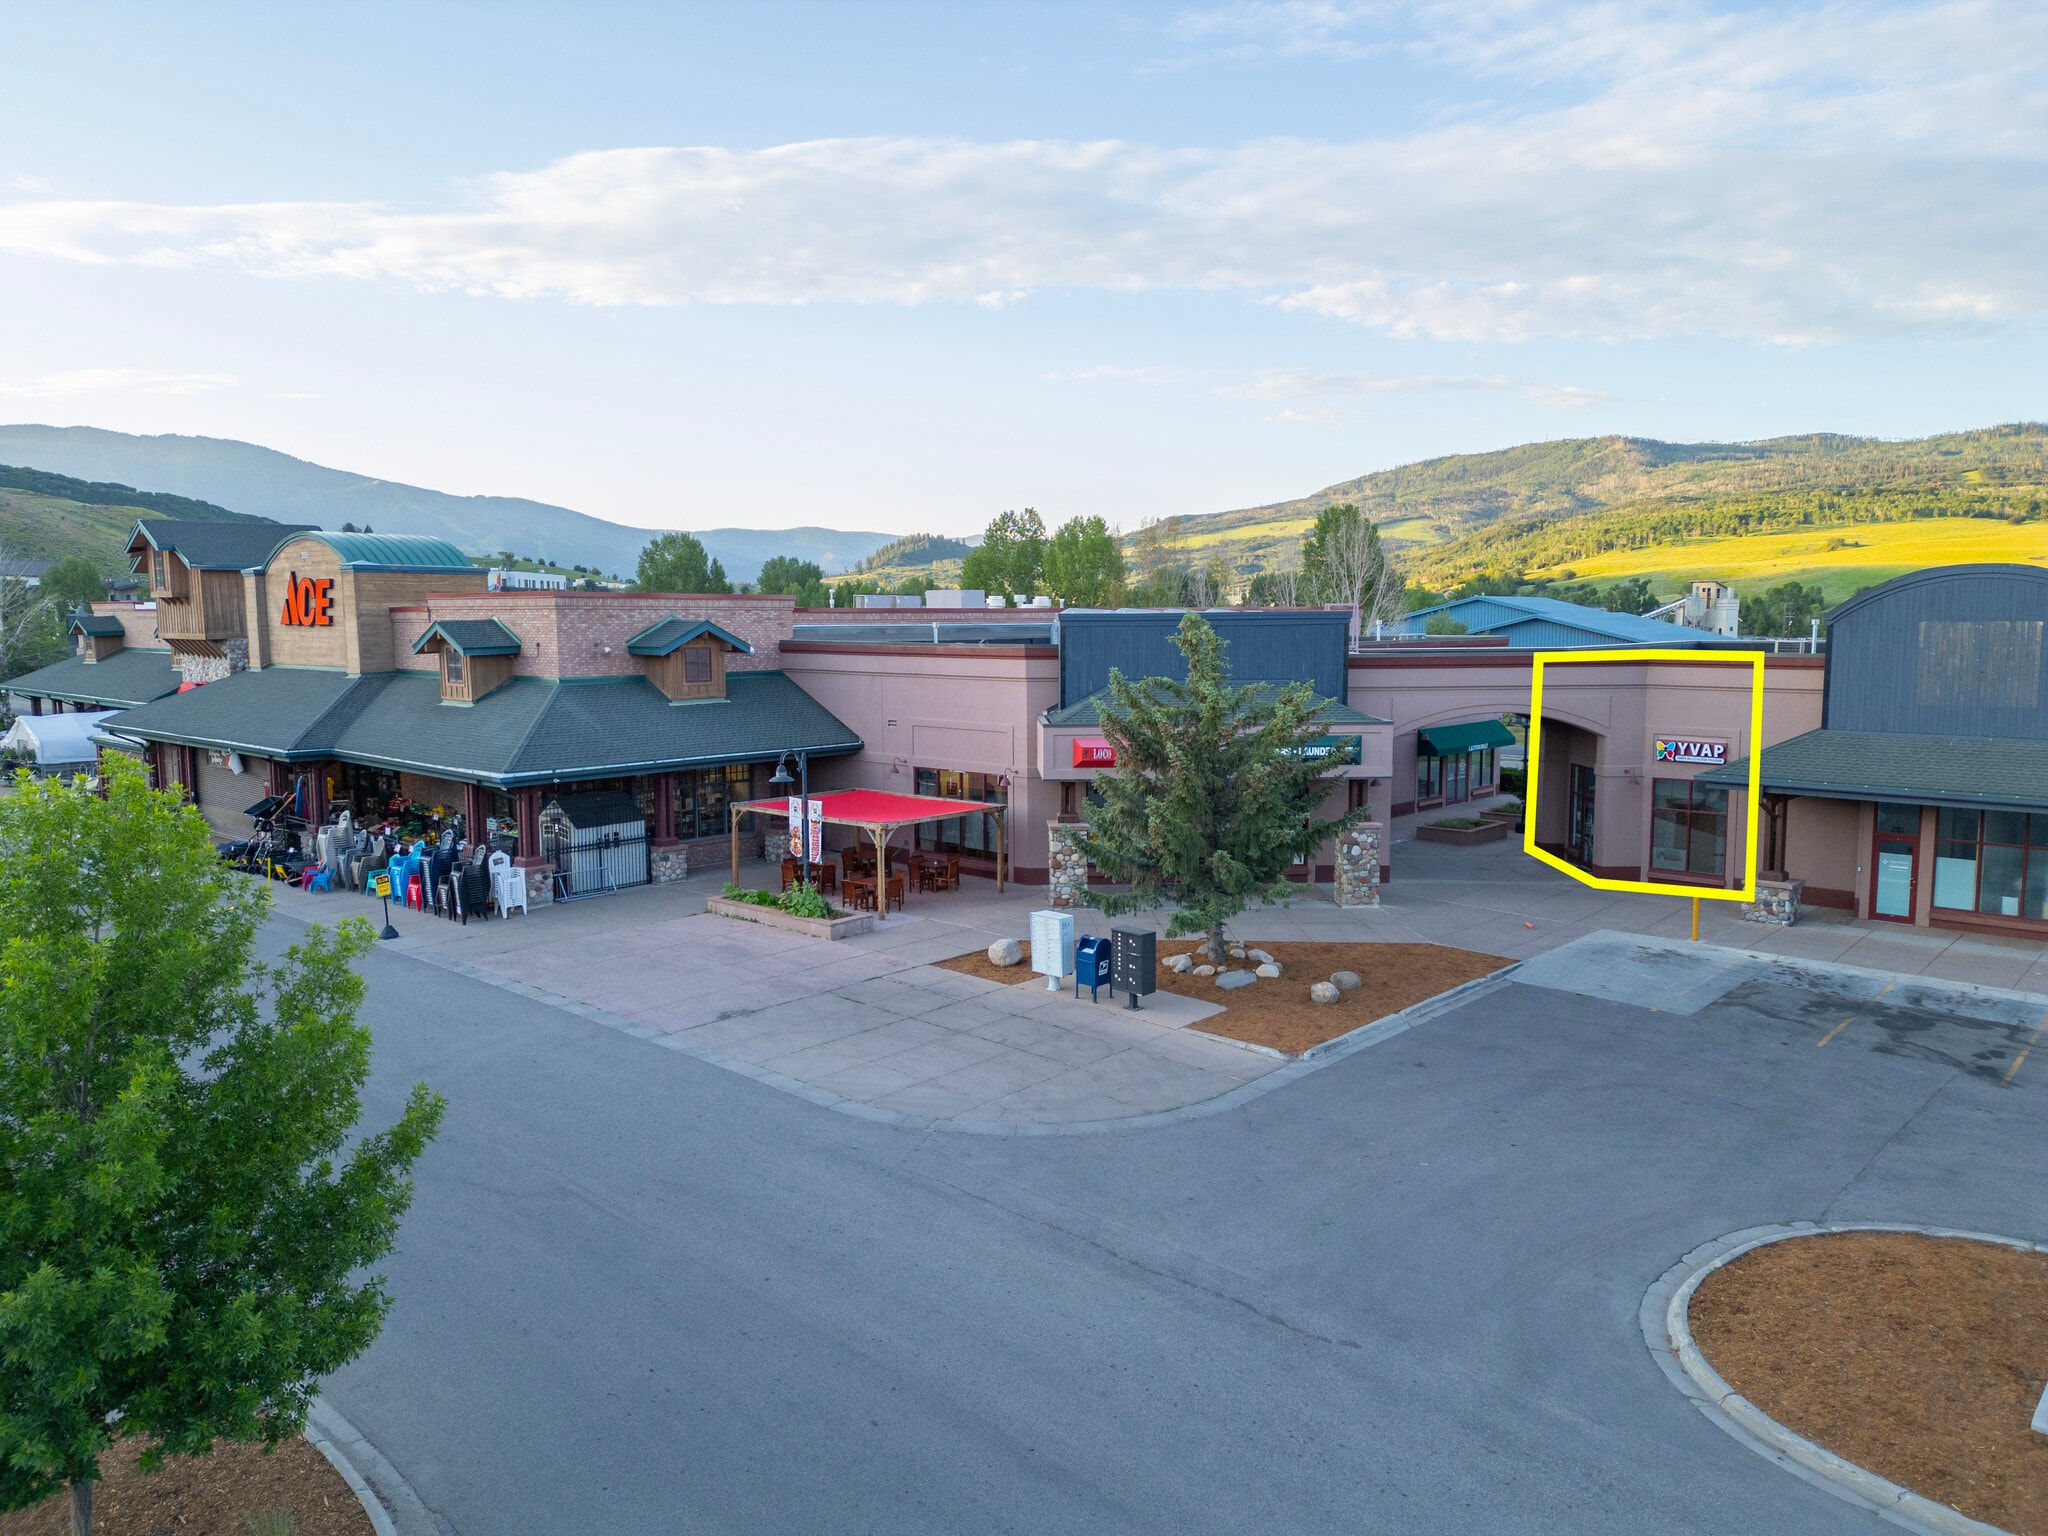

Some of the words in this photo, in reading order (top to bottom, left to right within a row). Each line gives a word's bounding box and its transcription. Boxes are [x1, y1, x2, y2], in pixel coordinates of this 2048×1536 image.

[280, 571, 334, 627] ACE
[1093, 748, 1112, 759] LOCO
[1677, 742, 1724, 757] YVAP
